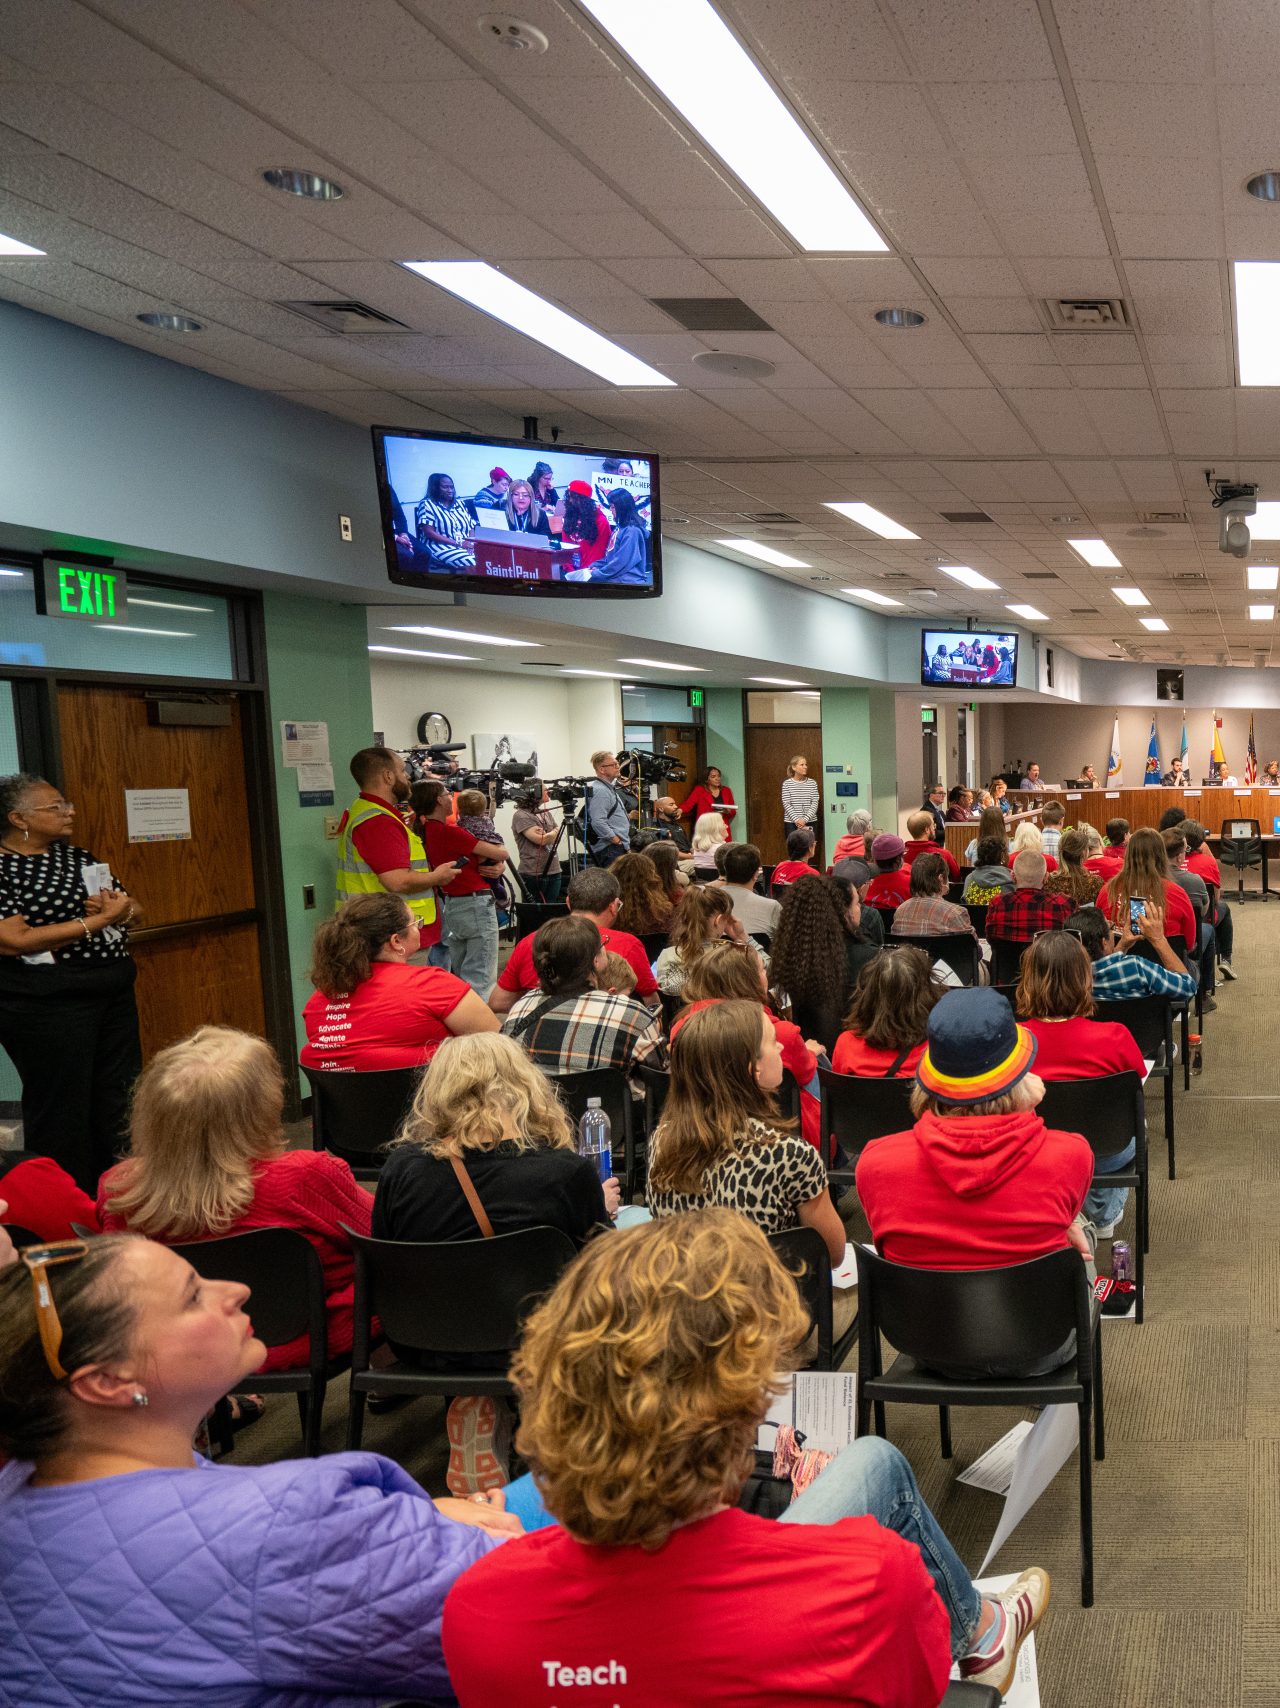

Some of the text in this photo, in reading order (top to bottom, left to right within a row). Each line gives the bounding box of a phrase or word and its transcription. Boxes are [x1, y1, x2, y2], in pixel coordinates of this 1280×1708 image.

[486, 561, 538, 580] Saint Paul
[59, 567, 116, 617] EXIT
[326, 1002, 350, 1011] Inspire
[326, 1013, 346, 1021] Hope
[318, 1022, 352, 1032] Advocate
[542, 1660, 628, 1688] Teach
